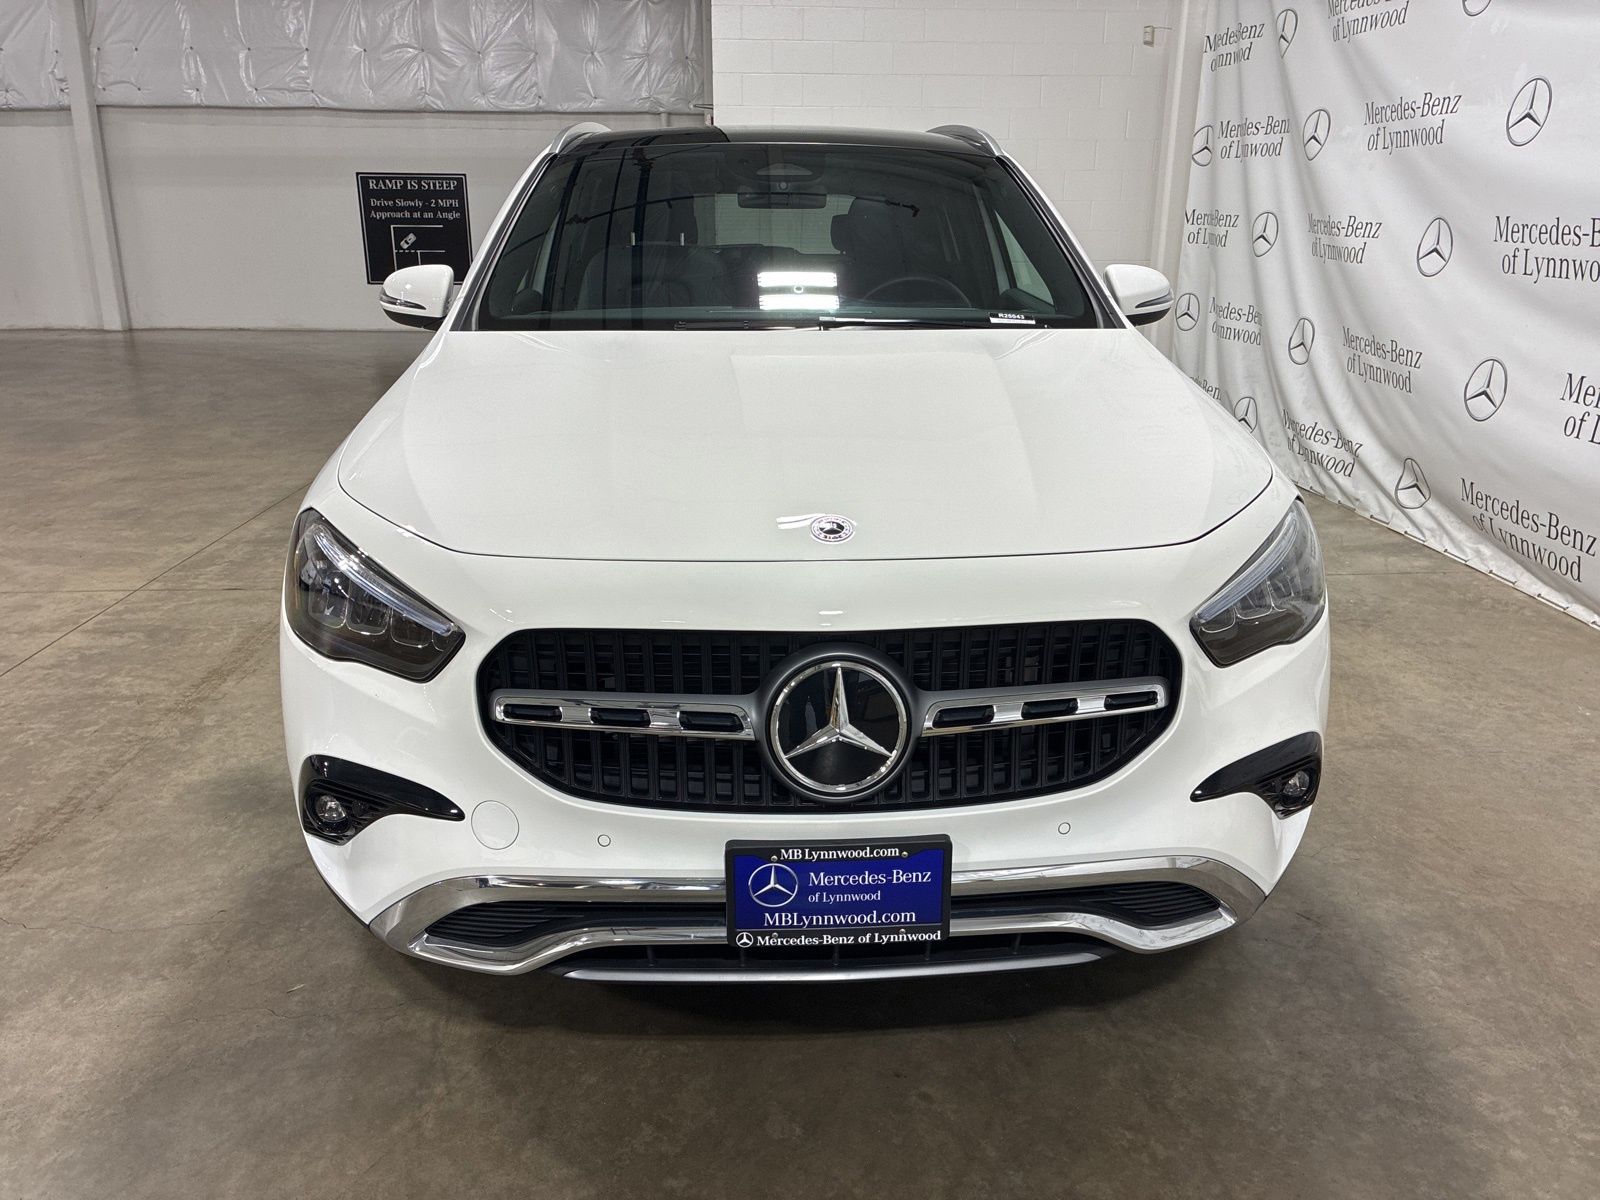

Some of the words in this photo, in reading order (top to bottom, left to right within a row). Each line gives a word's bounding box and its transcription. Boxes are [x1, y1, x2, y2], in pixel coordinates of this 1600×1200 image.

[1341, 0, 1410, 43] Lynnwood
[1364, 92, 1462, 125] Mercedes-Benz
[1220, 140, 1234, 159] of
[1367, 126, 1381, 151] of
[1382, 119, 1445, 155] Lynnwood
[368, 179, 404, 190] RAMP
[407, 179, 418, 190] IS
[421, 180, 457, 190] STEEP
[370, 198, 394, 207] Drive
[395, 199, 423, 208] Slowly
[430, 199, 436, 207] 2
[437, 199, 459, 208] MPH
[370, 210, 411, 219] Approach
[412, 211, 421, 219] at
[436, 211, 461, 220] Angle
[1188, 227, 1201, 245] of
[1308, 212, 1382, 239] Mercedes-Benz
[1319, 237, 1367, 264] Lynnwood
[1502, 247, 1519, 275] of
[1343, 326, 1423, 369] Mercedes-Benz
[1347, 352, 1356, 374] of
[1357, 354, 1412, 394] Lynnwood
[1564, 411, 1590, 440] of
[1297, 439, 1356, 478] Lnnwood
[1460, 477, 1597, 557] Mercedes-Benz
[1472, 512, 1489, 535] of
[1488, 517, 1583, 583] Lynnwood
[808, 869, 932, 887] Mercedes-Benz
[808, 892, 820, 903] of
[822, 890, 881, 905] Lynnwood
[764, 911, 916, 928] MBLynnwood.com
[757, 933, 855, 947] Mercedes-Benz
[858, 933, 872, 943] of
[874, 930, 942, 944] Lynnwood
